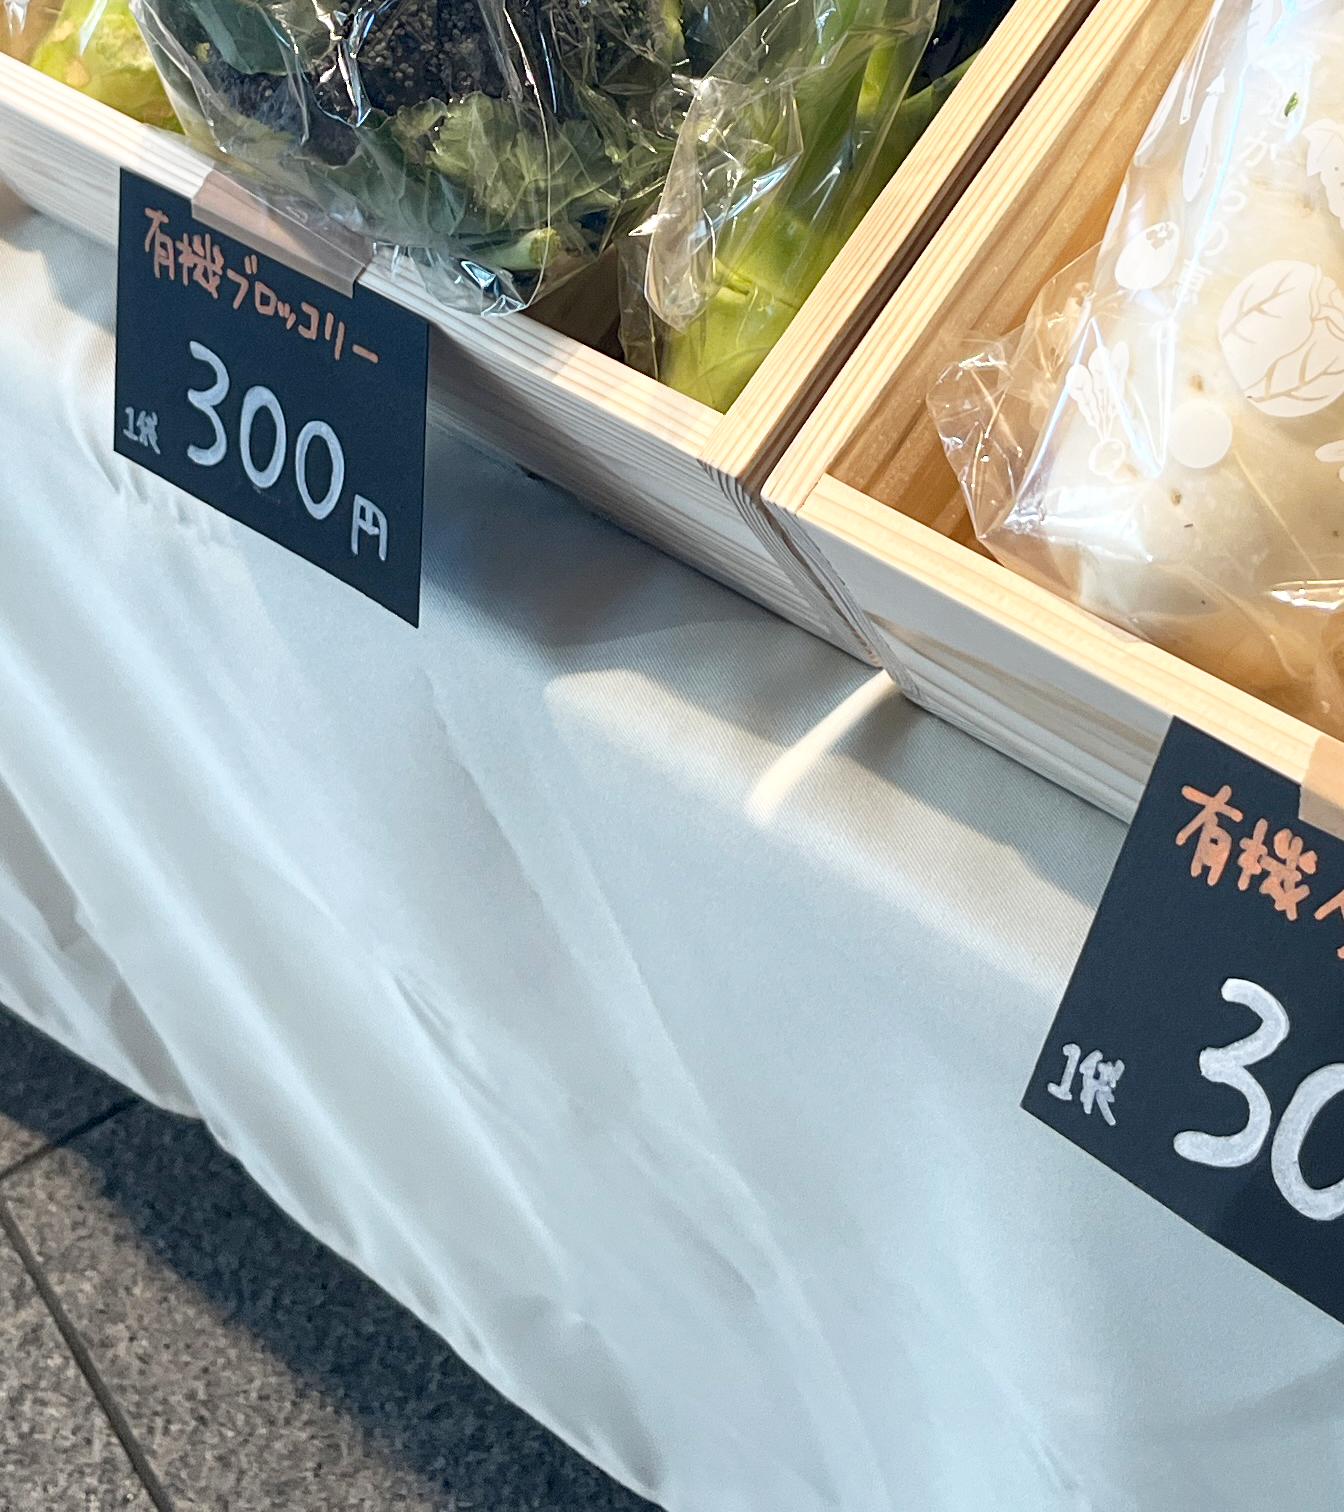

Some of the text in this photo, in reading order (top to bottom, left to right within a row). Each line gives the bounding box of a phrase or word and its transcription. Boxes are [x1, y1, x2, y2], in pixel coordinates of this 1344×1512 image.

[143, 206, 380, 365] 有機ブロッコリー
[186, 340, 390, 563] 300円
